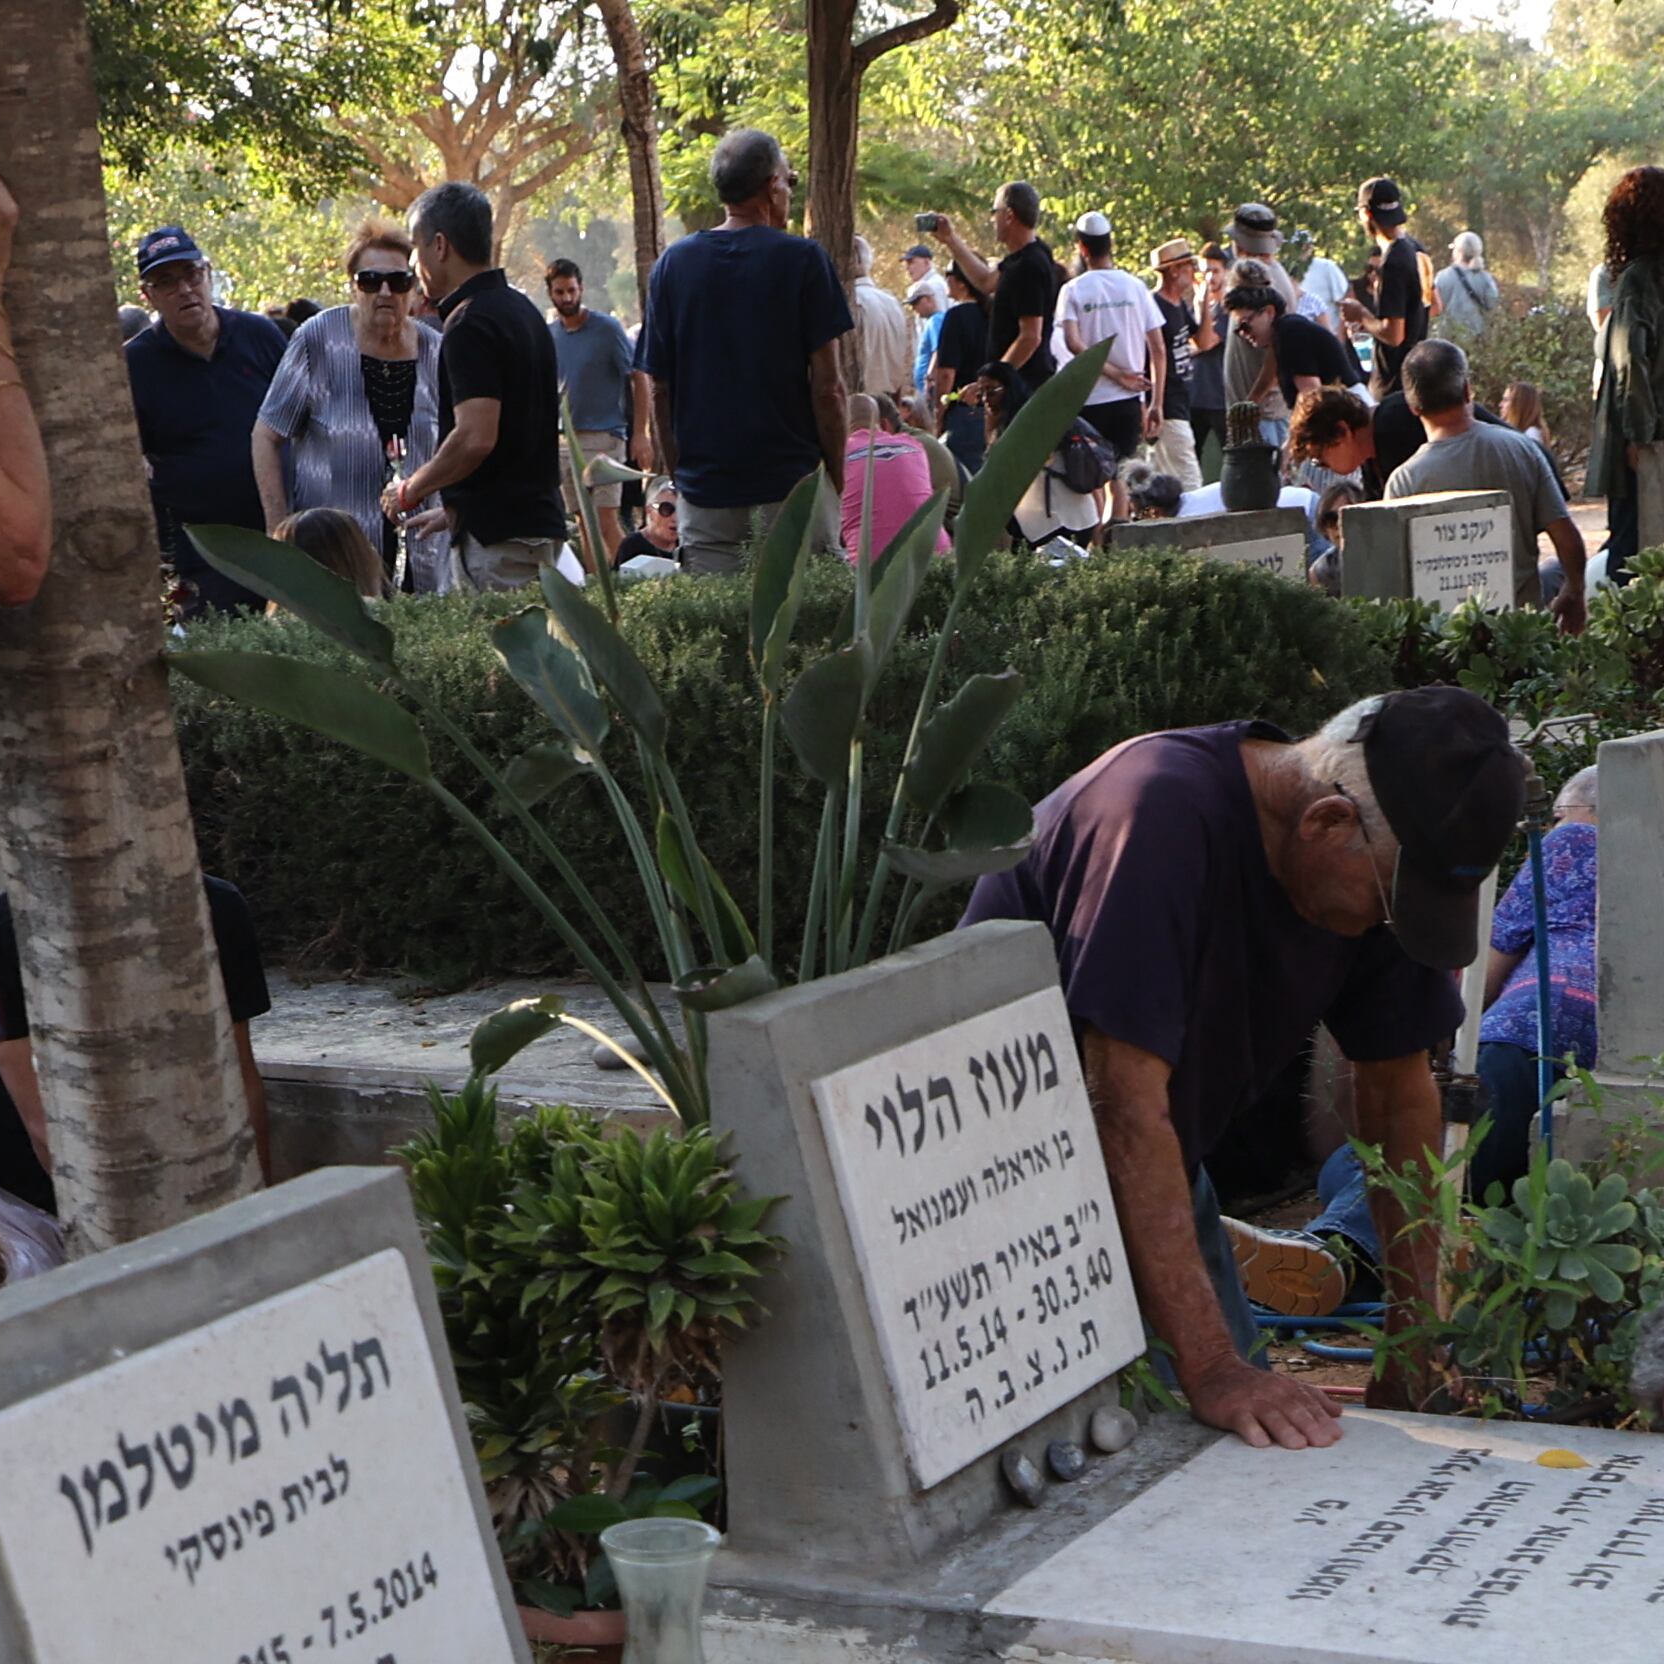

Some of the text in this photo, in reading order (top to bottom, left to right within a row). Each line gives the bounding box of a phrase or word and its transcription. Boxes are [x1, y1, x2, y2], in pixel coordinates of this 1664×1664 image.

[863, 1031, 1060, 1157] מעוז הלוי
[890, 1129, 1076, 1245] בן אראלה ועמנואל
[994, 1223, 1063, 1283] באייר
[918, 1306, 1009, 1391] 11.5.14
[1031, 1246, 1114, 1326] 30.3.40
[57, 1336, 391, 1556] תליה מיטלמן
[164, 1453, 350, 1583] לבית פינסקי
[1285, 1447, 1493, 1601] בעלי אבינו סבנו וחמנו
[1404, 1480, 1536, 1576] האהוב והיקר
[1440, 1452, 1646, 1630] אדם נדיר, אהוב הבריות
[1566, 1562, 1623, 1591] ולב
[1595, 1528, 1653, 1560] דרך
[320, 1551, 439, 1648] 7.5.2014
